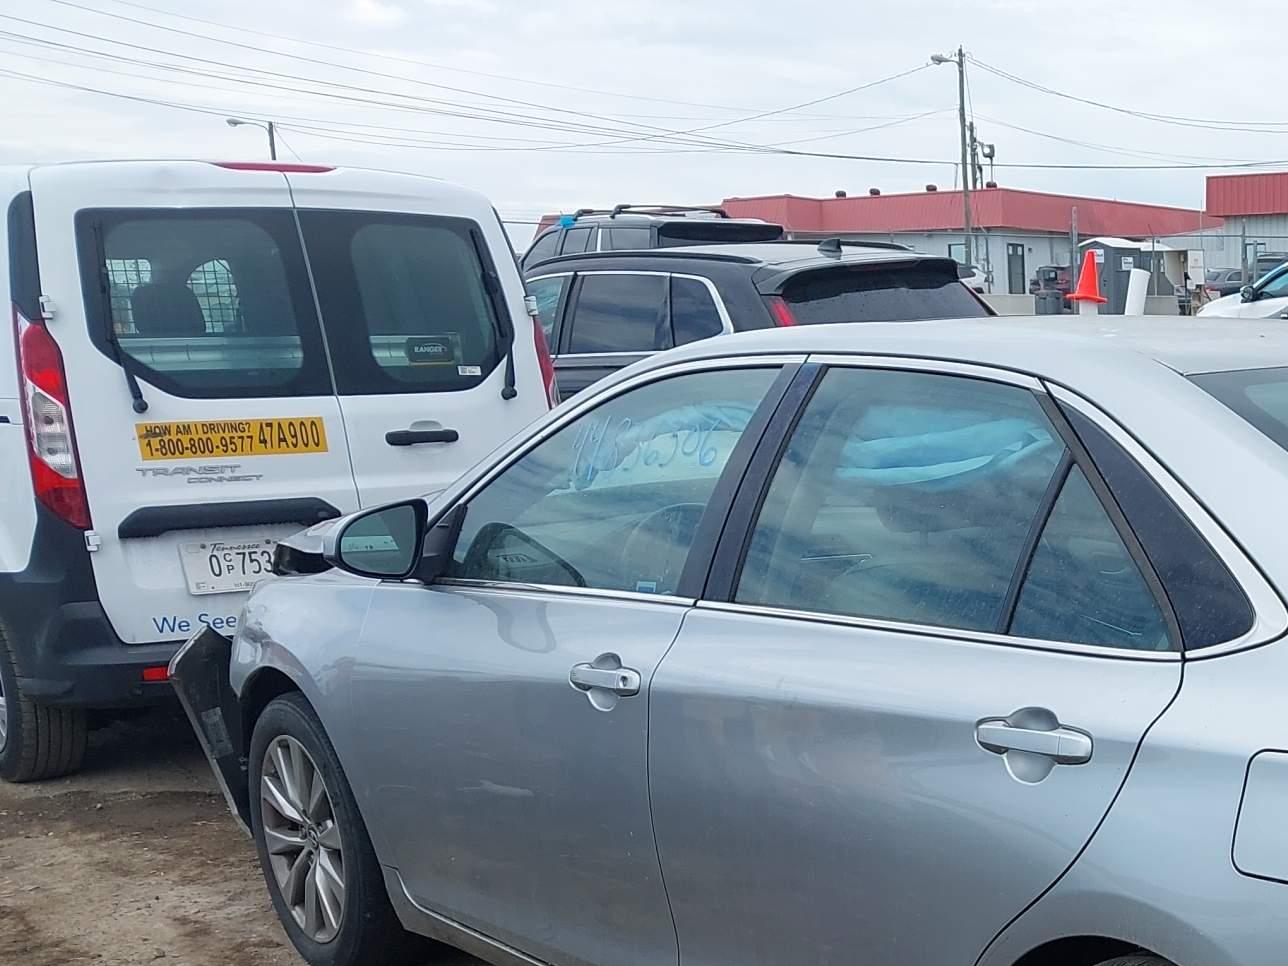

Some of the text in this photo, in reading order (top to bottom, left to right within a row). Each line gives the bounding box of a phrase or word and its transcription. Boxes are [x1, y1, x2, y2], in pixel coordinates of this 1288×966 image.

[144, 422, 251, 438] HOW AM I DRIVING?
[258, 420, 320, 449] 47A900
[146, 435, 254, 457] 1-800-800-9577
[136, 464, 242, 477] TRANSIT
[187, 474, 263, 484] CONNECT
[152, 613, 237, 633] We See
